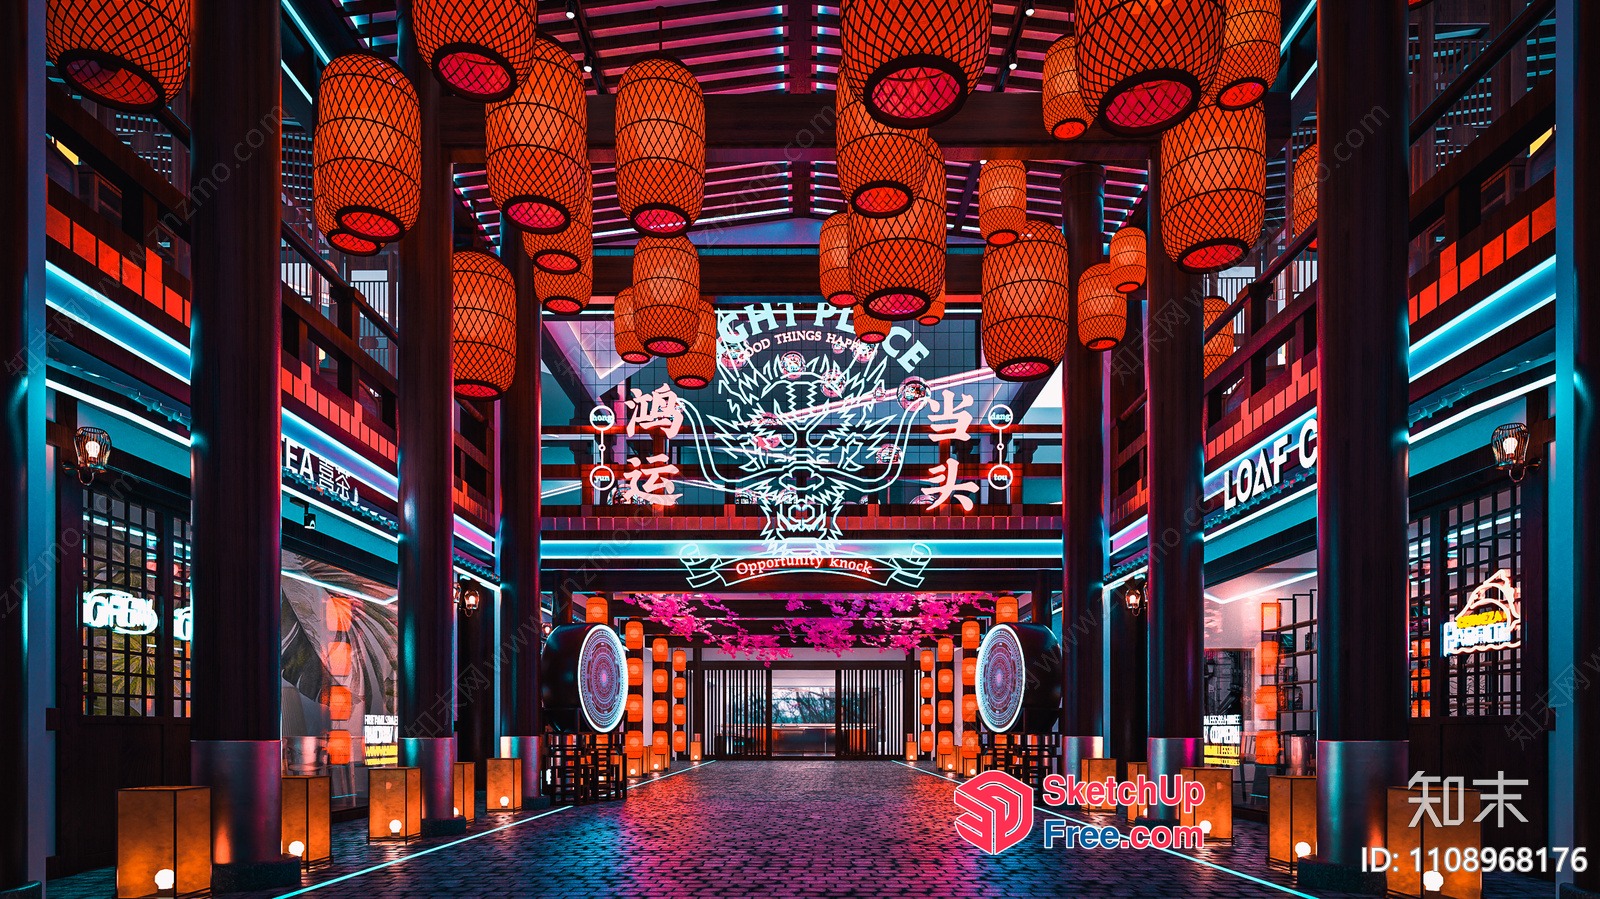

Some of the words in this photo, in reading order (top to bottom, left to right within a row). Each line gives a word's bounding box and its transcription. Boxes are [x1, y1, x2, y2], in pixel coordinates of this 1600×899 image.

[774, 330, 822, 345] THINGS
[813, 303, 930, 374] PLCE
[990, 412, 1012, 422] dang
[920, 389, 980, 511] 当头
[993, 473, 1008, 481] tou
[829, 554, 873, 575] knock
